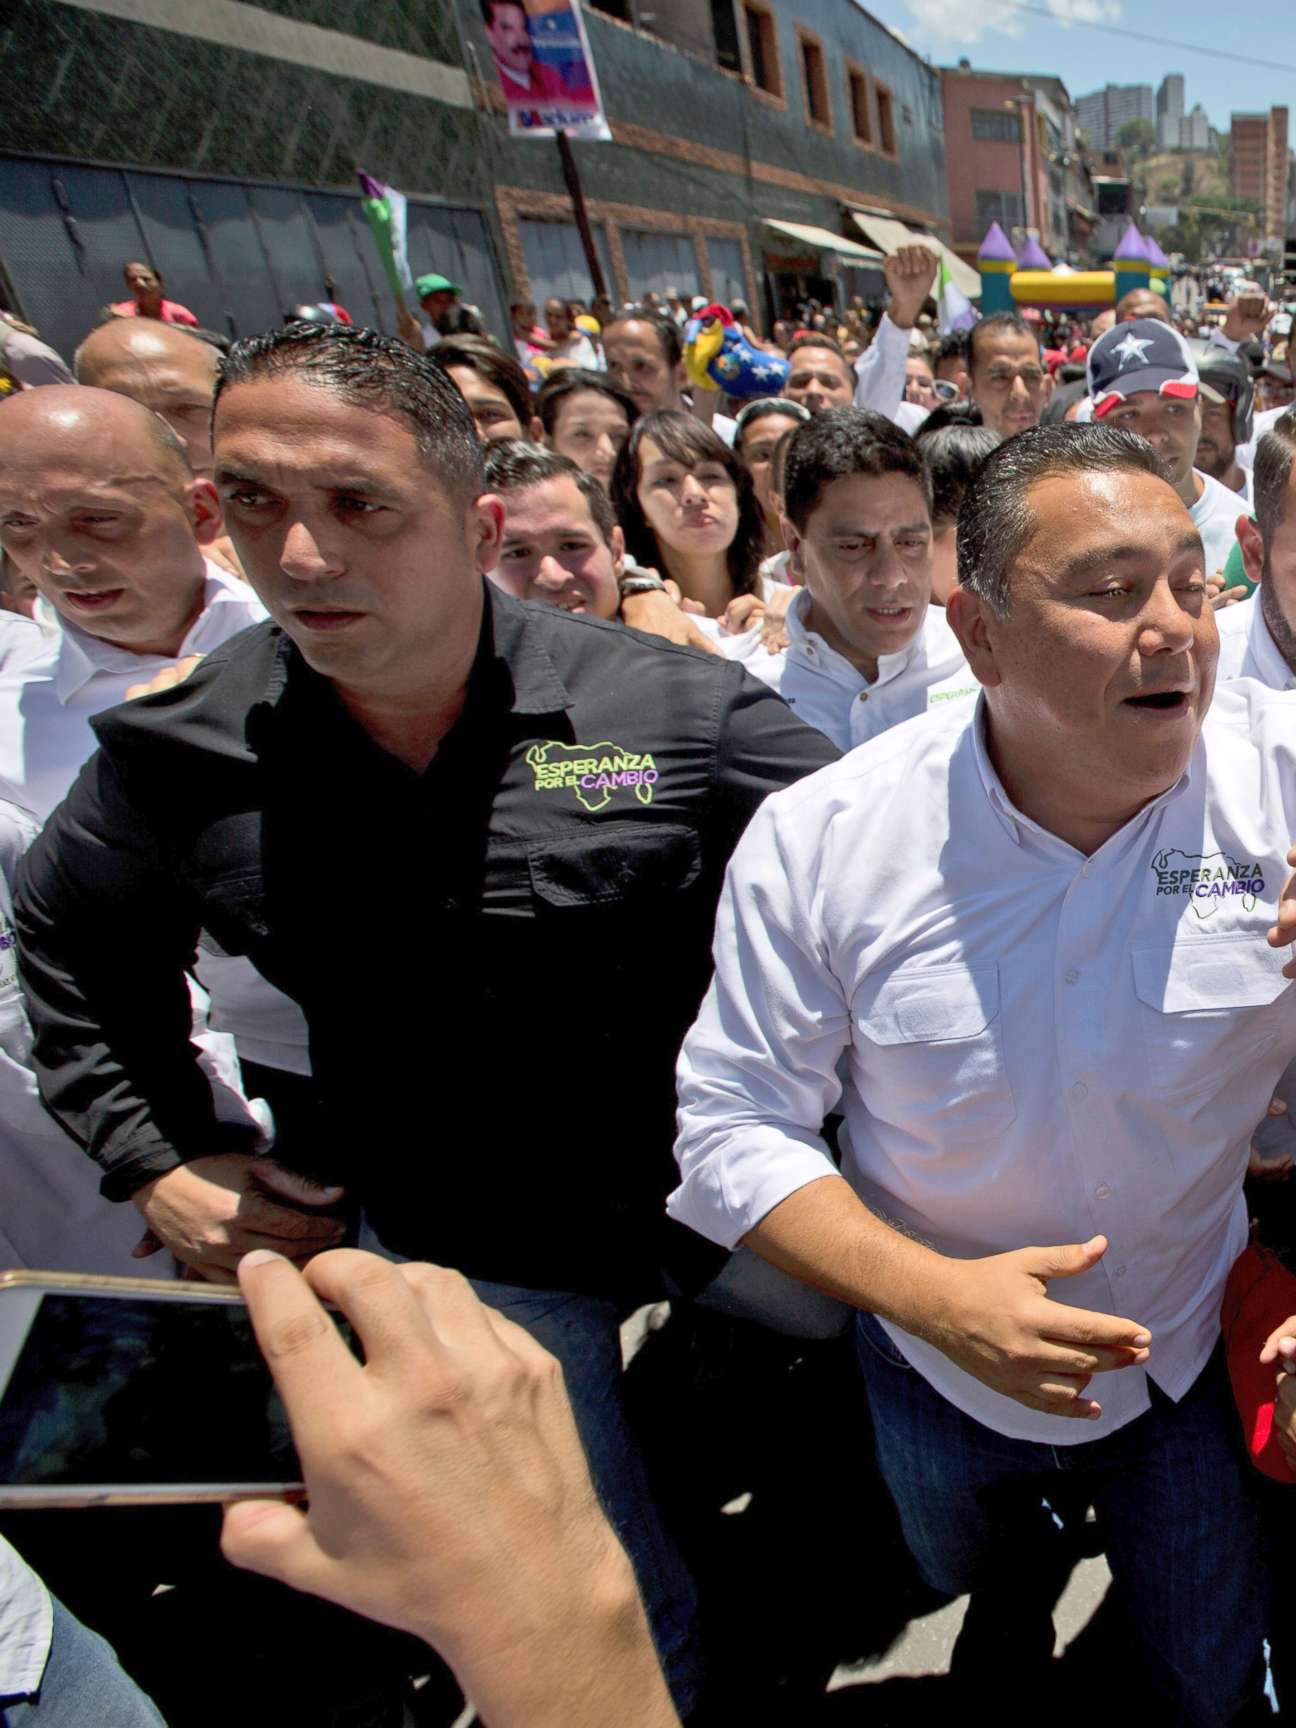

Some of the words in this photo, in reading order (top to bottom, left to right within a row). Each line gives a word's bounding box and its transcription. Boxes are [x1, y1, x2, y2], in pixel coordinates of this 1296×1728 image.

[535, 754, 657, 779] ESPERANZA
[534, 776, 562, 791] POR
[565, 775, 580, 787] EL
[579, 769, 659, 789] CAMBIO
[1158, 863, 1263, 885] ESPERANZA
[1156, 885, 1180, 896] POR
[1182, 884, 1194, 893] EL
[1195, 879, 1265, 898] CAMBIO
